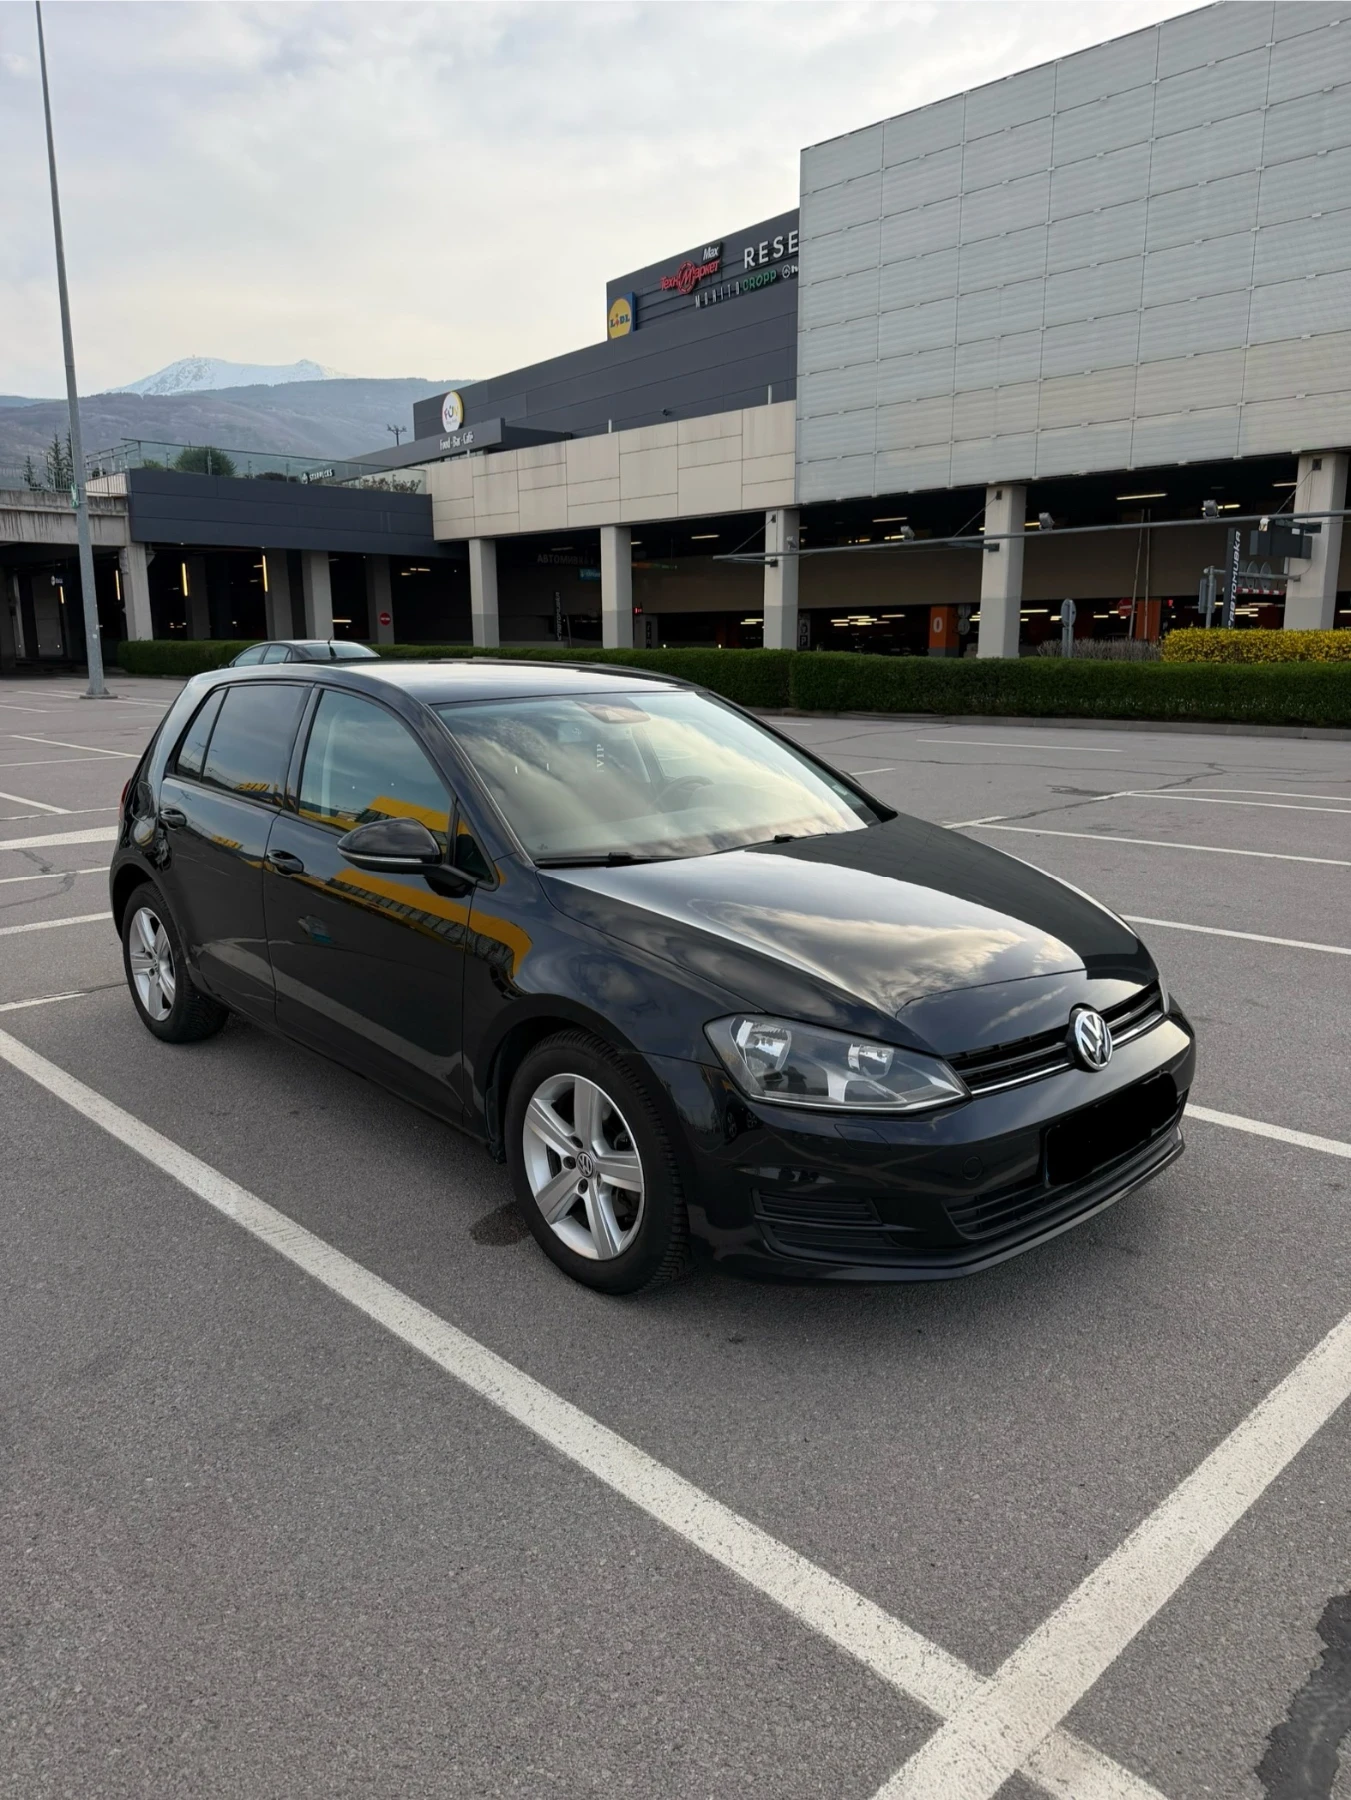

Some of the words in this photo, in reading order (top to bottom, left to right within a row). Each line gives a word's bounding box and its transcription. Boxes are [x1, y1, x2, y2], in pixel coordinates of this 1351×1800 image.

[703, 246, 719, 261] Max
[744, 230, 798, 269] RESE
[742, 270, 777, 291] CROPP
